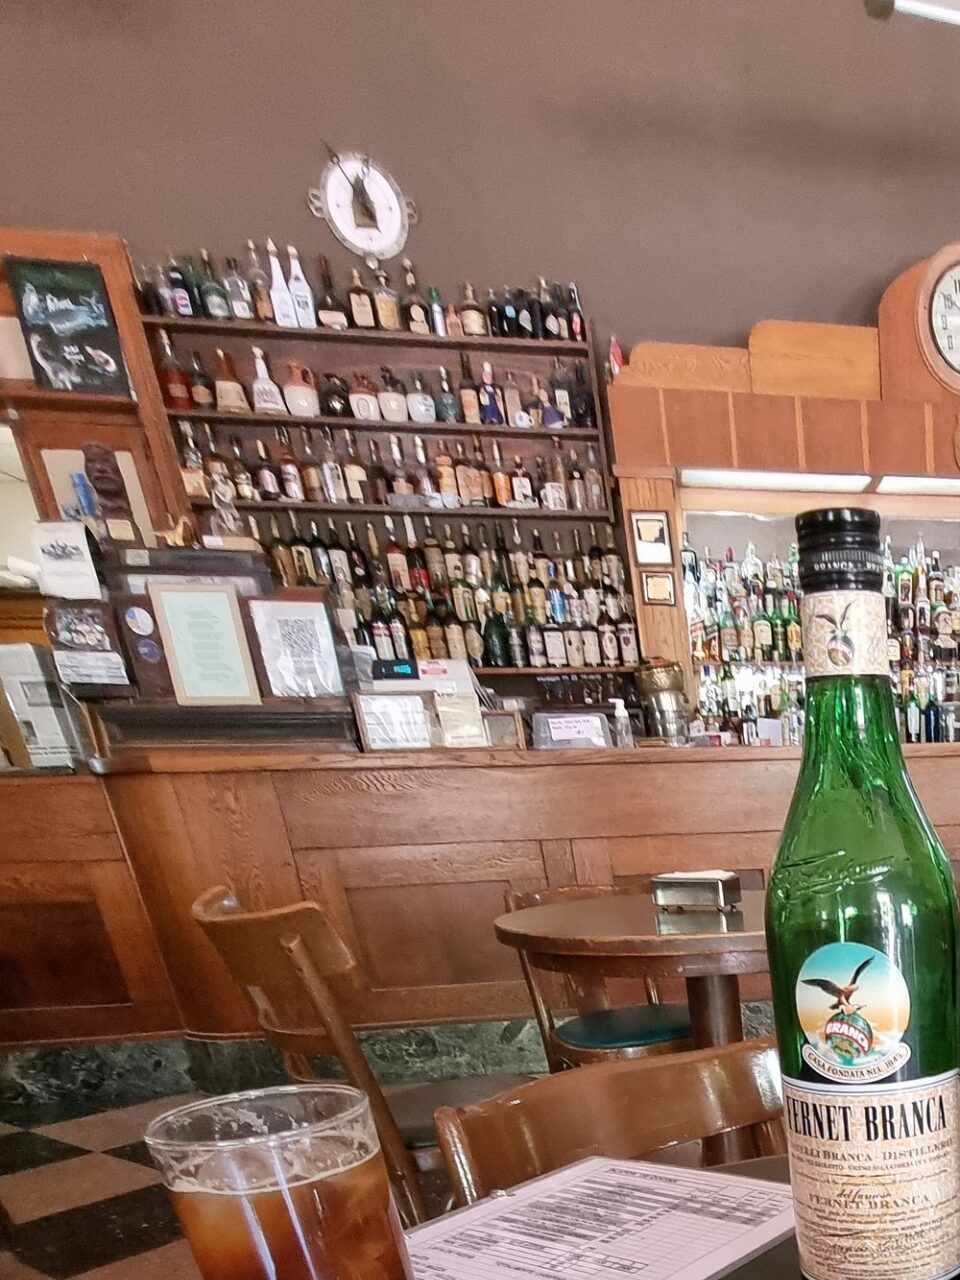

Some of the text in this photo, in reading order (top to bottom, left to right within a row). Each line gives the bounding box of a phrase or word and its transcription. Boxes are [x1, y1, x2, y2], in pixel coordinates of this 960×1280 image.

[941, 315, 948, 330] 9
[947, 335, 954, 350] 8
[826, 1021, 869, 1052] BRANCA
[807, 1052, 826, 1071] CASA
[826, 1065, 865, 1078] FONDATA
[866, 1066, 882, 1076] NEL
[786, 1095, 947, 1142] FERNET BRANCA
[822, 1149, 873, 1162] BRANCA
[809, 1194, 865, 1210] FERNET
[867, 1194, 930, 1210] BRANCA
